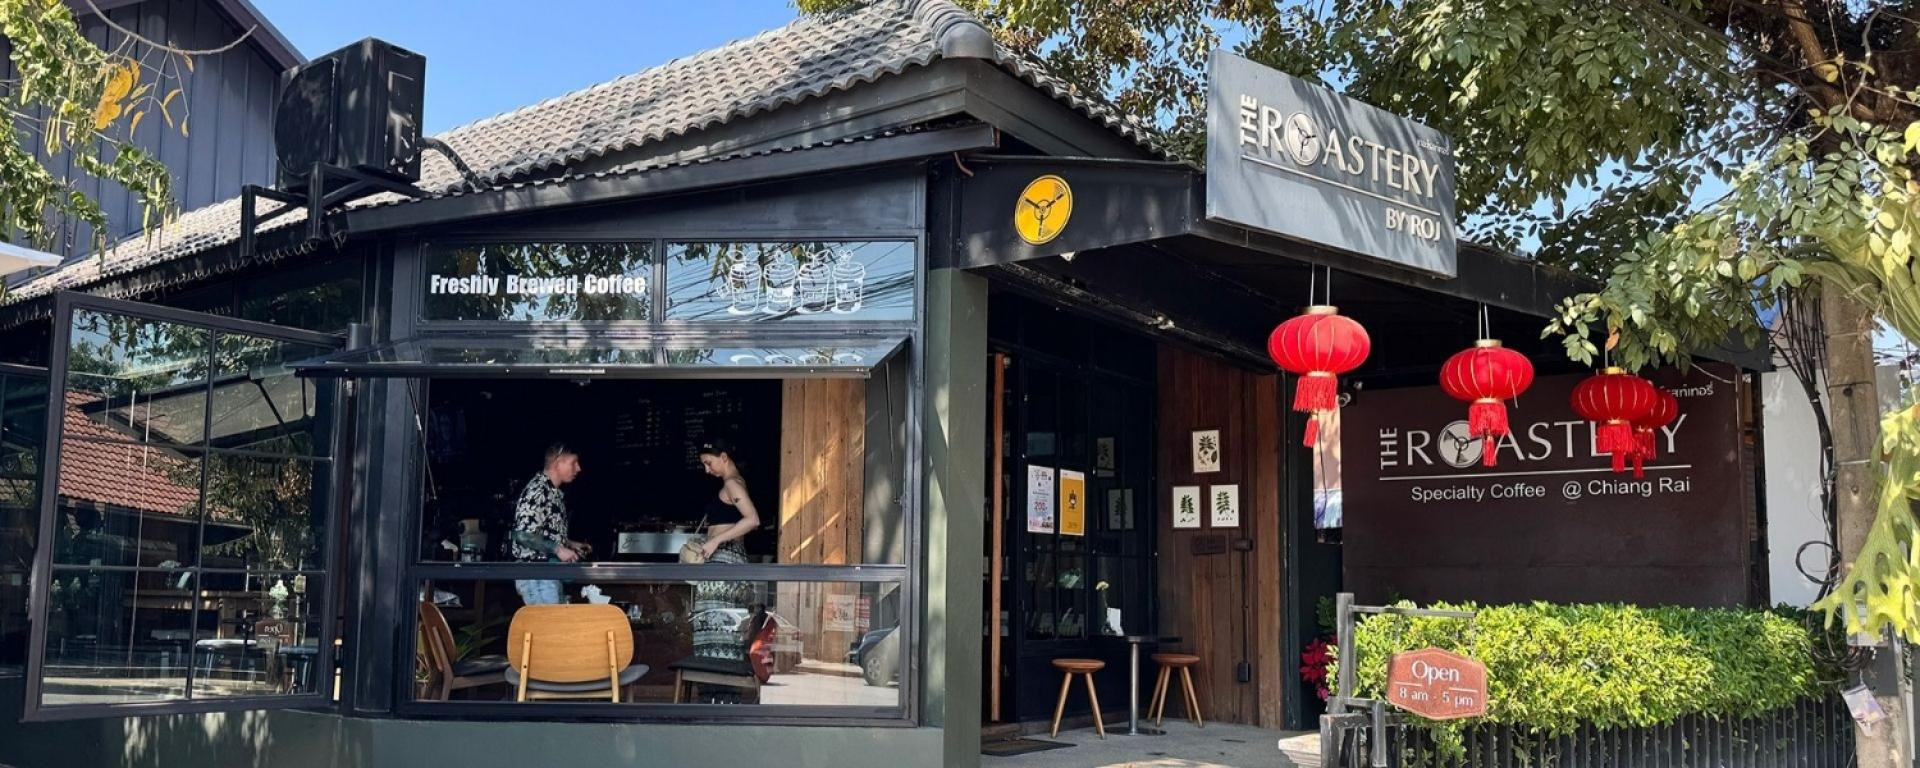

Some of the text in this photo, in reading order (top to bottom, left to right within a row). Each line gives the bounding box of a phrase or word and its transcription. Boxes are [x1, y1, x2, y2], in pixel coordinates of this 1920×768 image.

[1240, 94, 1258, 147] THE
[1261, 105, 1439, 198] ROASTERY
[1385, 207, 1441, 241] BY ROJ
[430, 273, 646, 296] Freshly Brewed Coffee
[1380, 427, 1398, 470] THE
[1411, 475, 1691, 504] Specialty Coffee @ Chiang Rai
[1411, 660, 1460, 685] Open
[1399, 687, 1408, 699] 8
[1411, 690, 1429, 701] am
[1442, 691, 1450, 703] 5
[1454, 695, 1474, 708] pm
